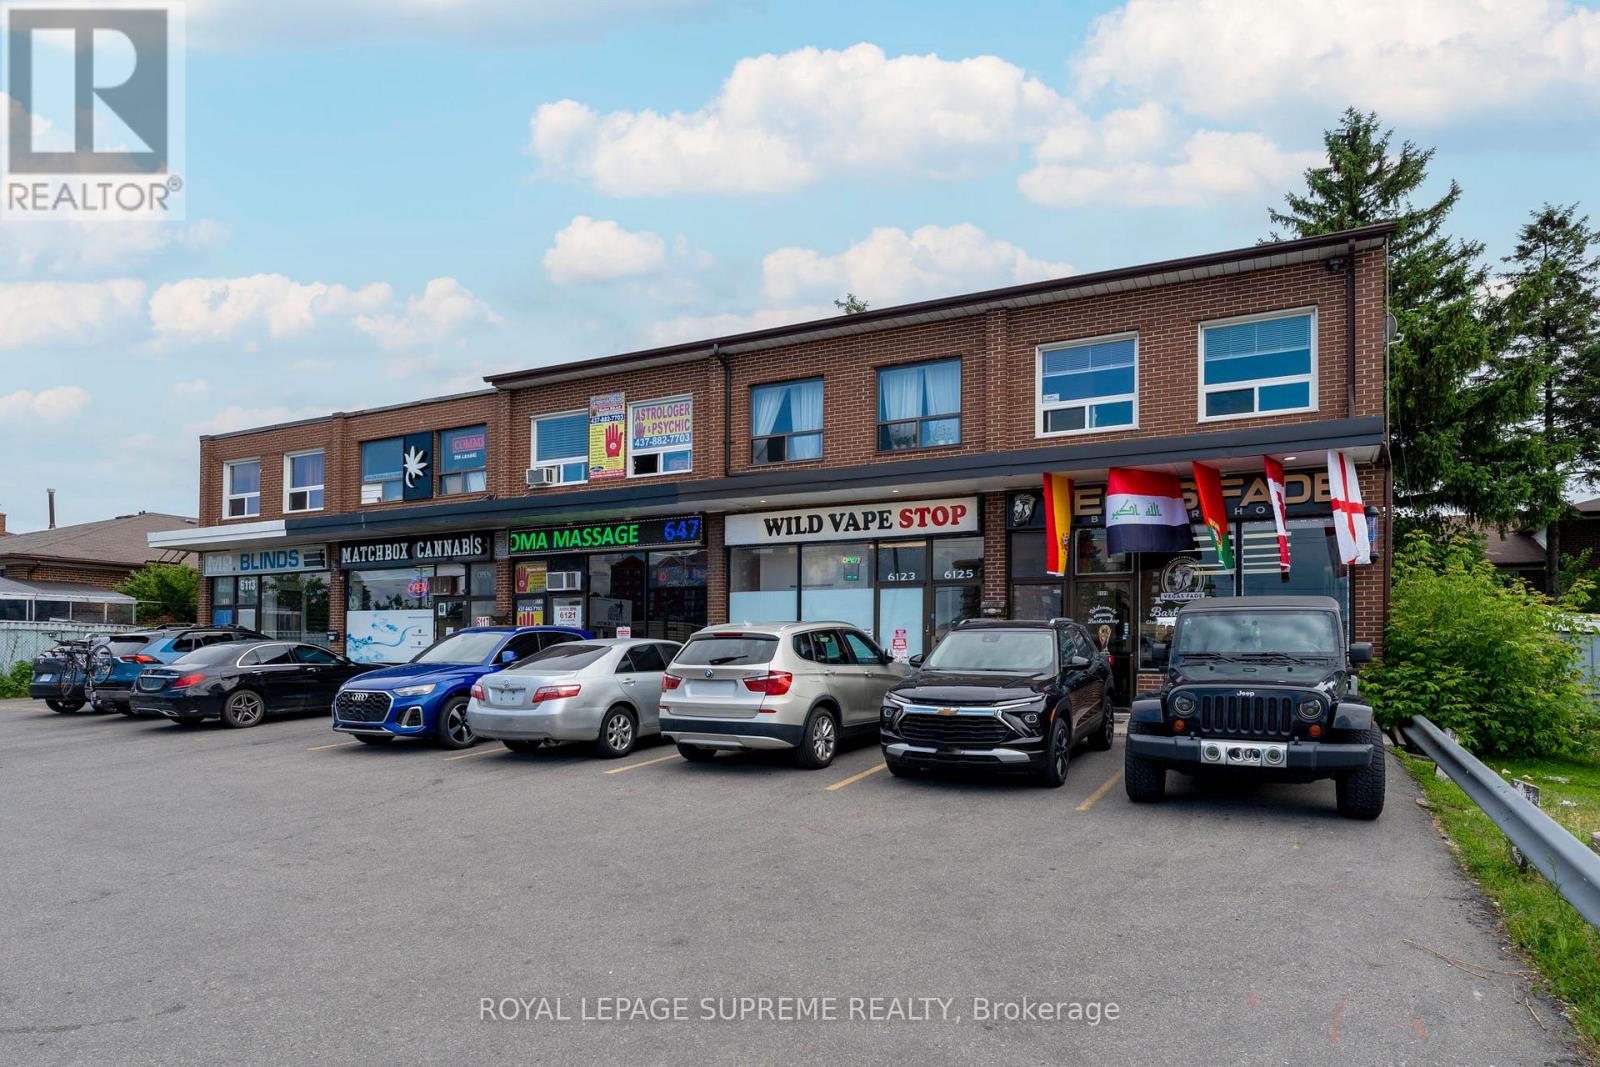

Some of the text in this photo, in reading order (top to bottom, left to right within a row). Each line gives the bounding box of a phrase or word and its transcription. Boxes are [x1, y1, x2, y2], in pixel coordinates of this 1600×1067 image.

[634, 403, 690, 422] ASTROLOGER
[651, 419, 690, 434] PSYCHIC
[634, 433, 690, 447] 437-882-7703
[763, 504, 967, 537] WILD VAPE STOP
[553, 524, 639, 548] MASSAGE
[664, 519, 699, 541] 647
[341, 537, 482, 564] MATCHBOX CANNABIS
[240, 549, 299, 571] BLINDS
[887, 572, 916, 581] 6123
[943, 569, 974, 579] 6125
[559, 611, 576, 619] 6121
